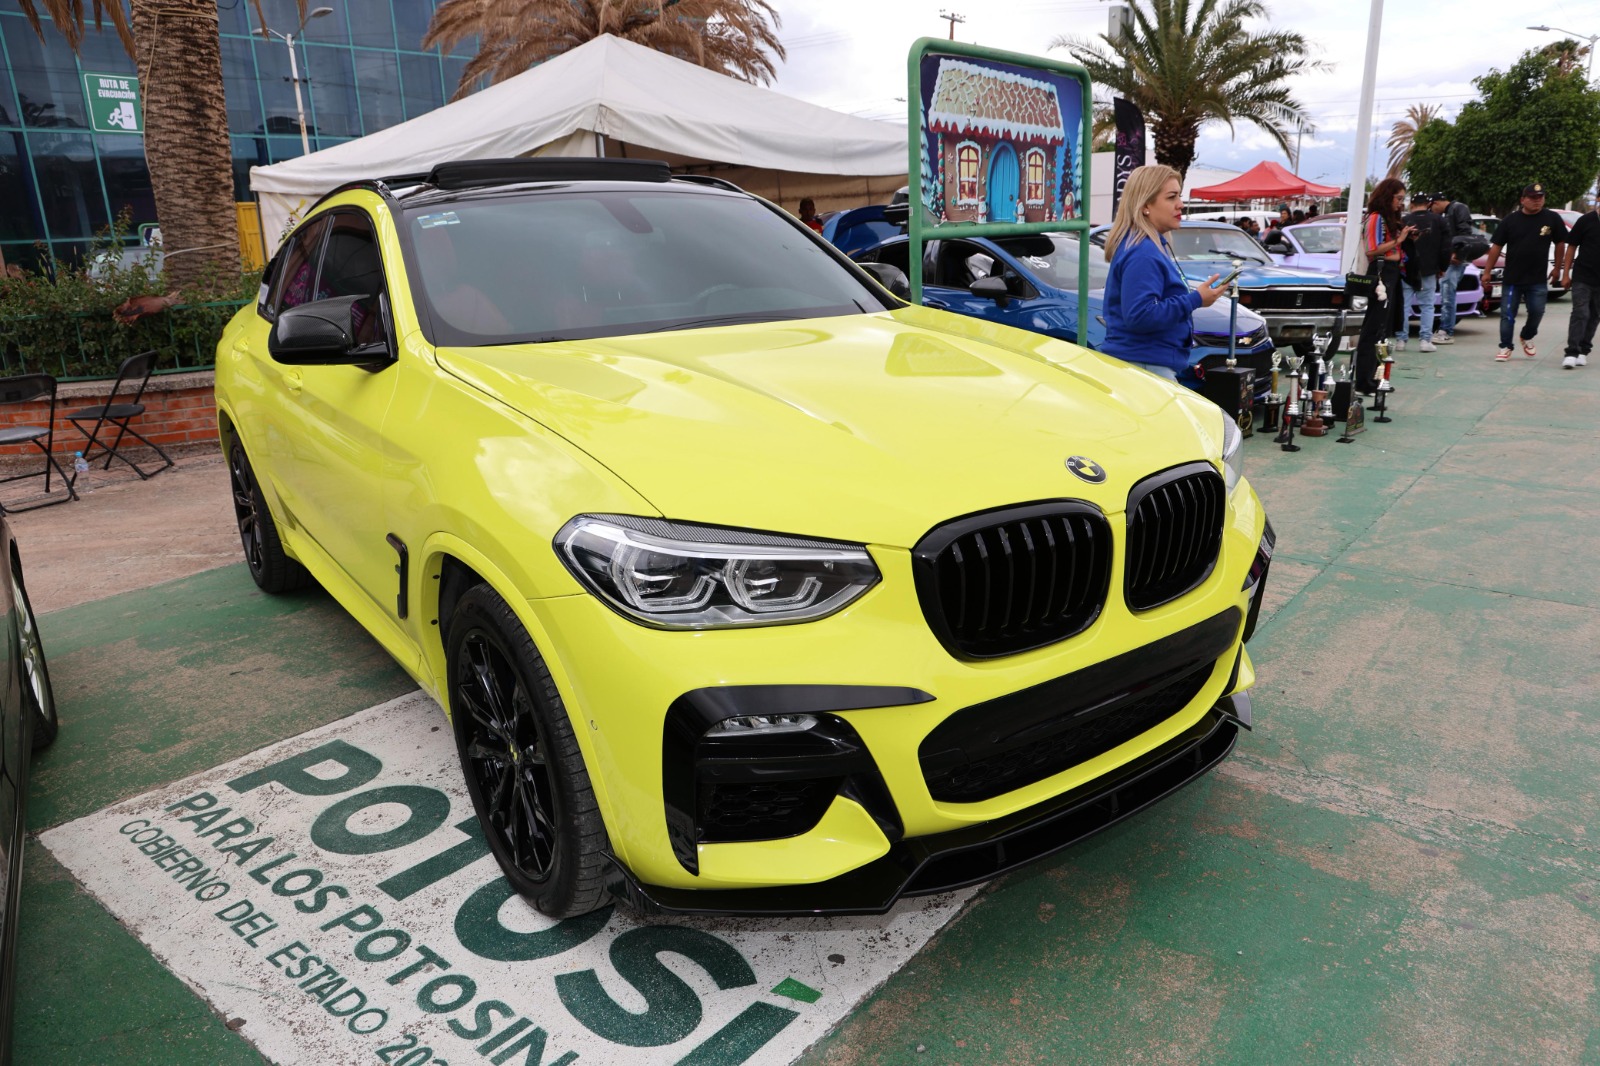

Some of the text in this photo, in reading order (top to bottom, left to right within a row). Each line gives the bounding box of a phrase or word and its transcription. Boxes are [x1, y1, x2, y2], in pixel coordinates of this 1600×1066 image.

[98, 89, 136, 99] EVACUACIÓN
[99, 79, 129, 89] RUTA DE
[164, 792, 275, 866] PARA
[248, 851, 349, 914] LOS
[215, 899, 278, 949] DEL
[266, 942, 389, 1034] ESTADO
